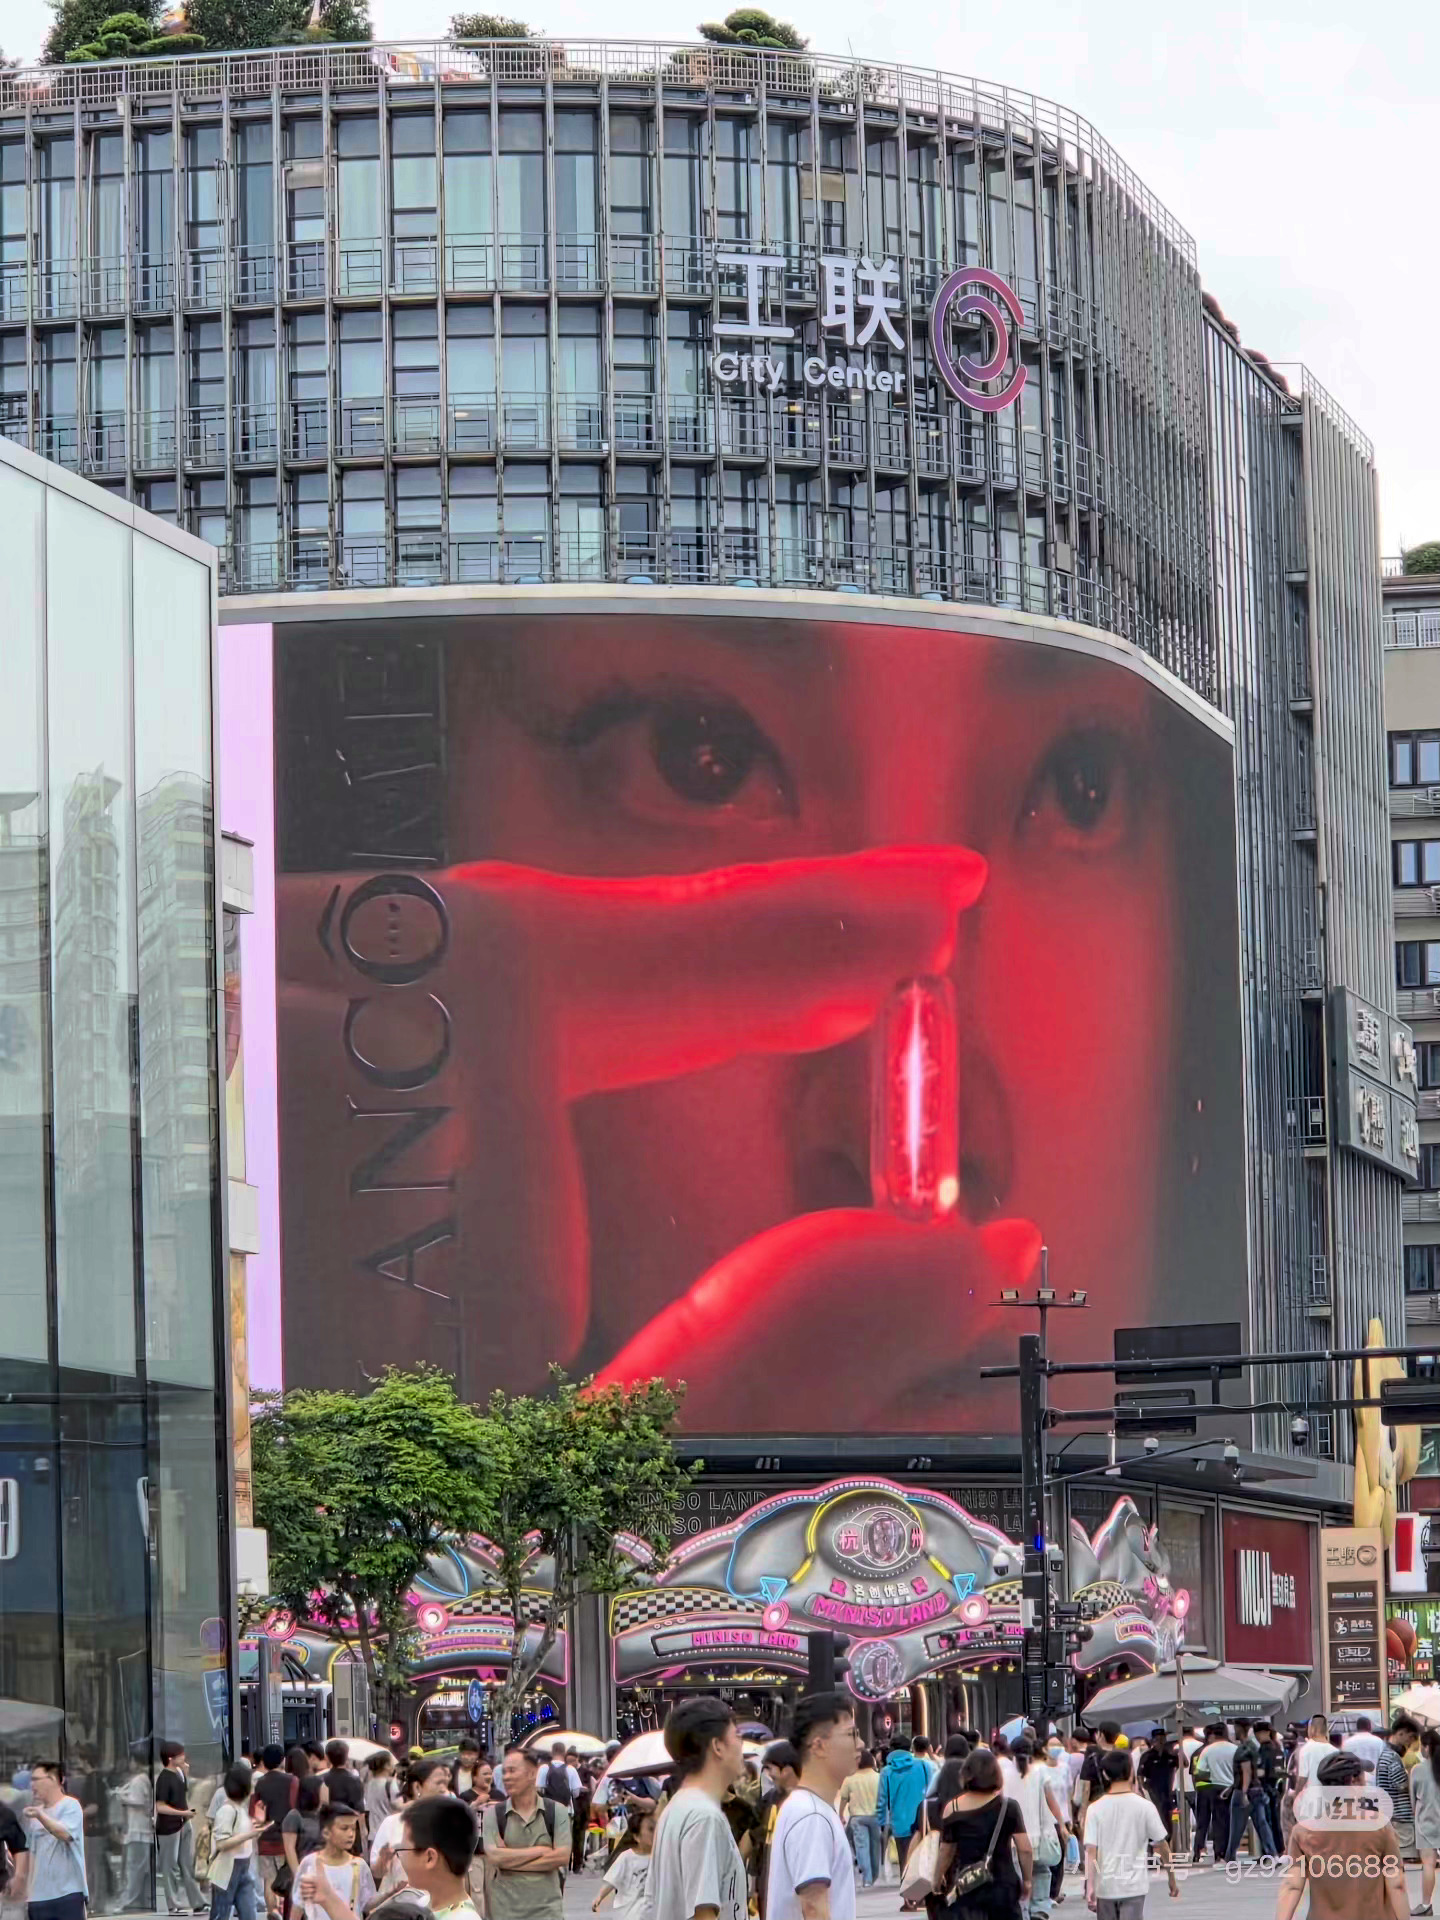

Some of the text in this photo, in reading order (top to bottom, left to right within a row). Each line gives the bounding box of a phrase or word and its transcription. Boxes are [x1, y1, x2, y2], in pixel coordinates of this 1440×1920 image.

[712, 253, 905, 350] 工联
[713, 352, 905, 393] City Center
[840, 1527, 924, 1550] 杭 州
[853, 1582, 910, 1599] 名创优品
[1240, 1549, 1272, 1627] MUJI
[812, 1591, 950, 1628] MINISO LAND
[692, 1630, 799, 1649] MINISO LAND
